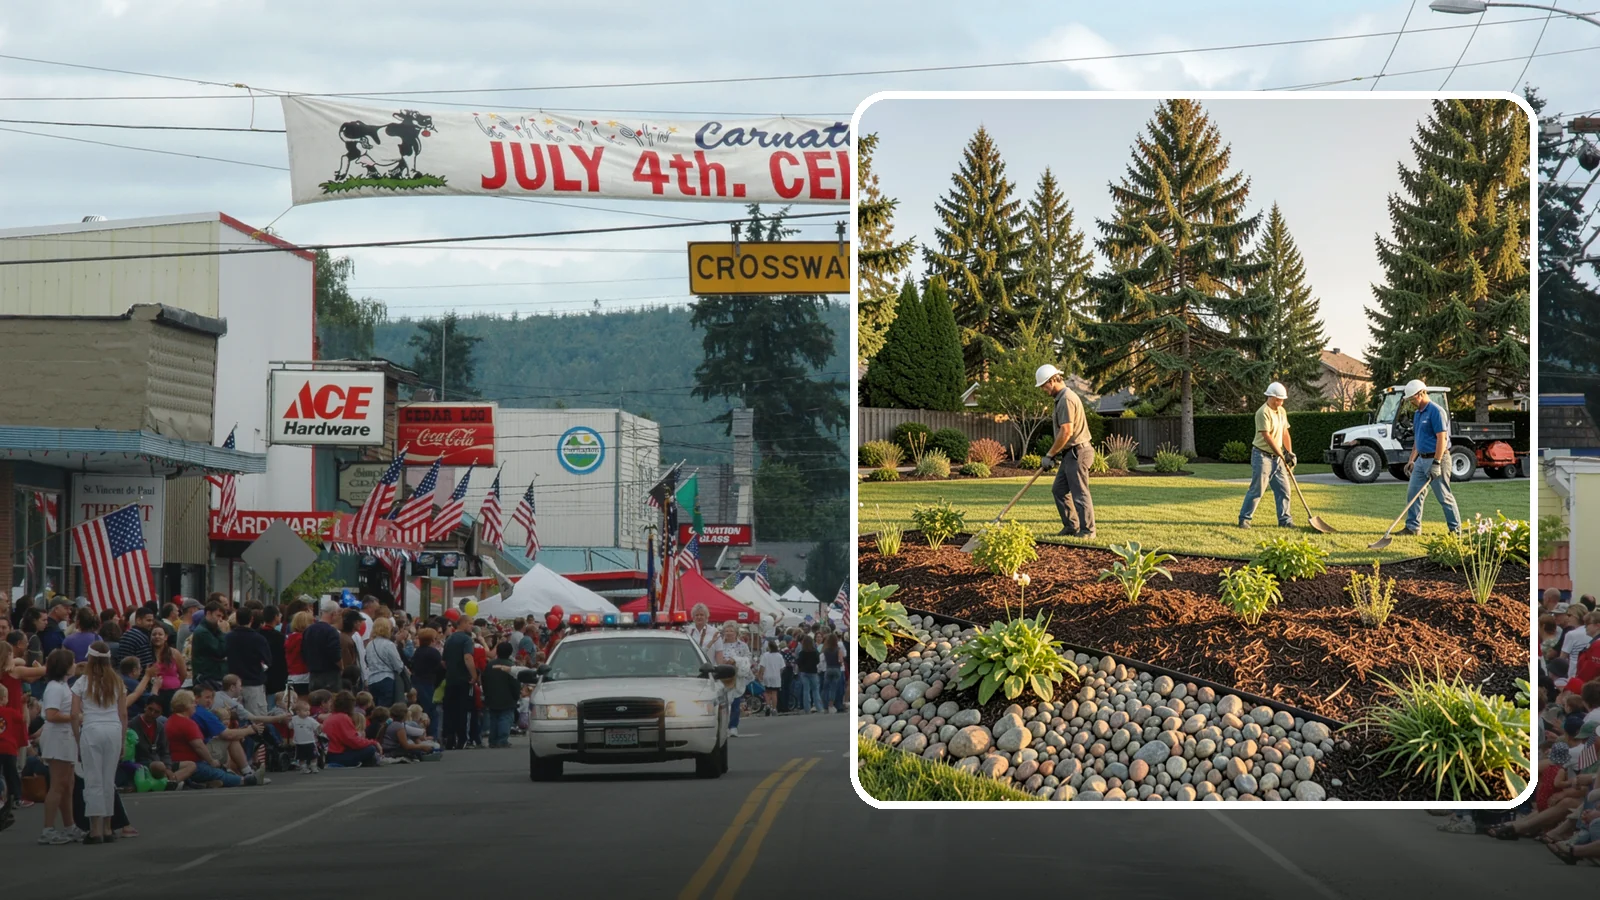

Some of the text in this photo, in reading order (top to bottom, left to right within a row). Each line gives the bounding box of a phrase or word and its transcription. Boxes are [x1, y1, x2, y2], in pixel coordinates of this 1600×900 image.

[481, 141, 604, 193] JULY
[632, 150, 746, 198] 4th.
[283, 379, 373, 420] ACE
[406, 409, 452, 421] CEDAR
[283, 421, 370, 436] Hardware
[416, 427, 477, 447] Coca-Cola
[83, 485, 155, 495] St. Vincent de Paul
[688, 526, 741, 535] CRNATION
[699, 535, 730, 543] GLASS
